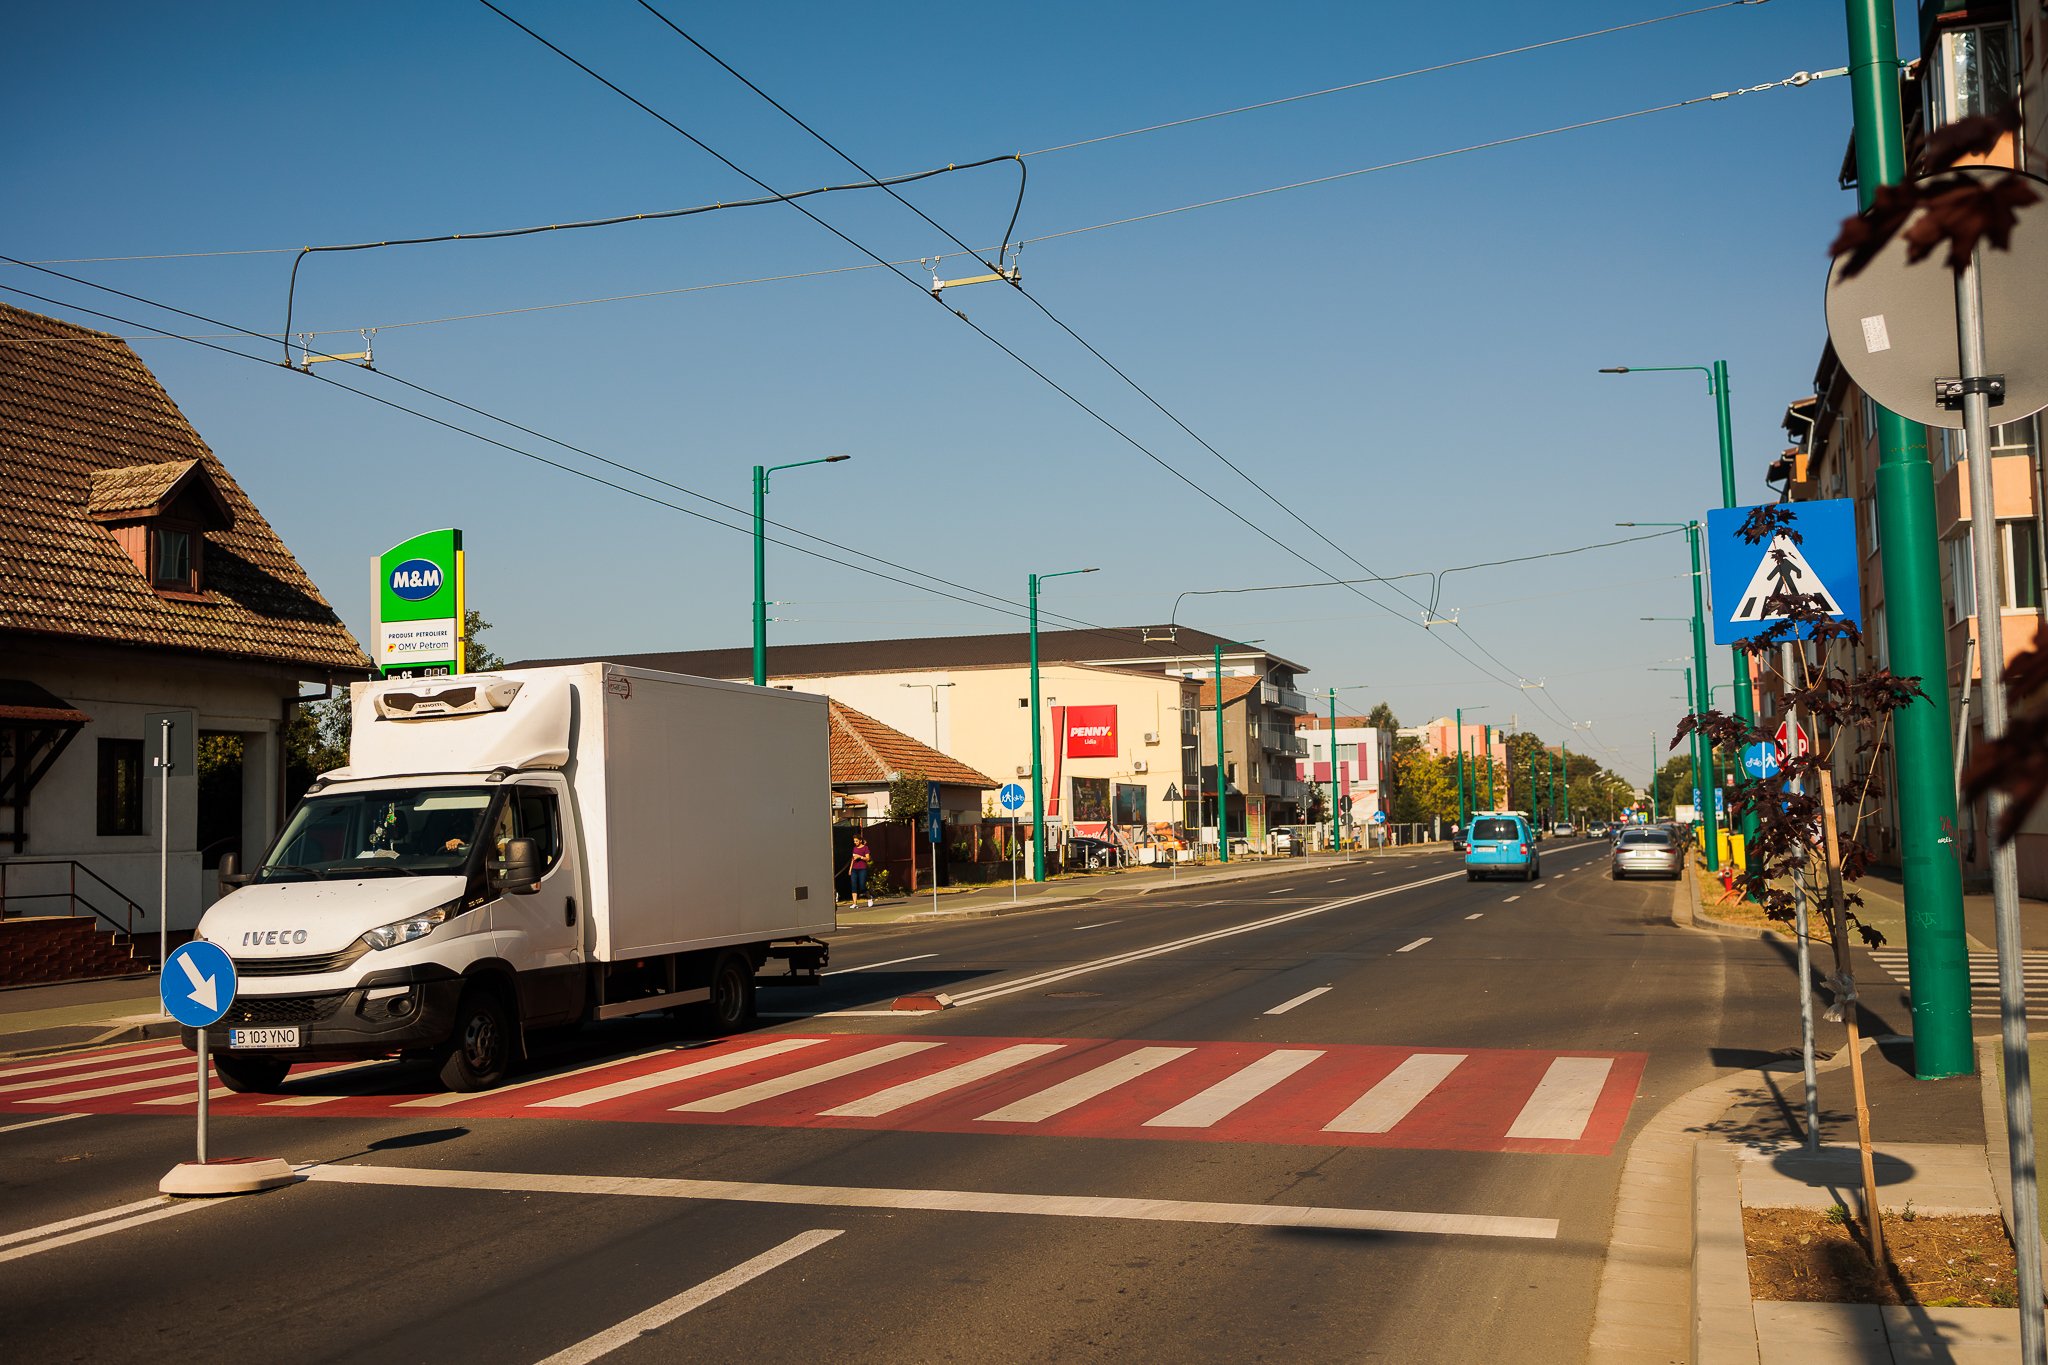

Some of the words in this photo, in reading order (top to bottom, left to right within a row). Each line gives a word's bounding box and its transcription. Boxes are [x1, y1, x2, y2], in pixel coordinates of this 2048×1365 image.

[393, 569, 440, 589] M&M
[415, 630, 448, 638] PETROLIERE
[398, 643, 417, 651] OMV
[419, 641, 449, 650] Petrom
[1776, 738, 1807, 762] STP
[242, 929, 308, 947] IVECO
[237, 1031, 246, 1044] B
[250, 1030, 267, 1044] 103
[269, 1029, 295, 1043] YNO
